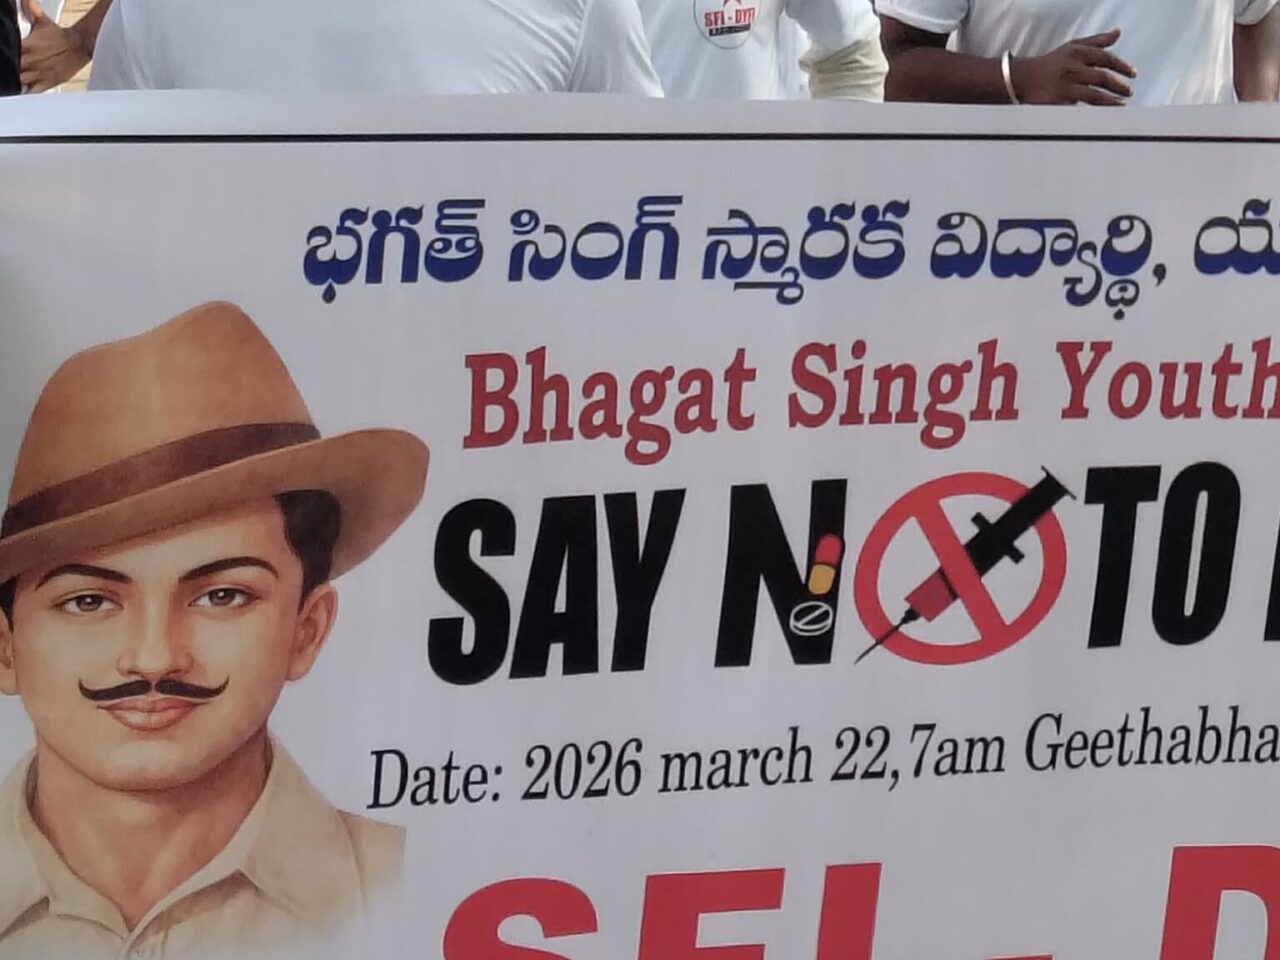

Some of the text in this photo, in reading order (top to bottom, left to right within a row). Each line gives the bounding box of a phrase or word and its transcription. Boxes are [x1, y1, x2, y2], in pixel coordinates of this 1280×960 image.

[704, 10, 725, 27] SFI
[303, 198, 486, 304] భగత్
[507, 194, 684, 282] సింగ్
[701, 200, 910, 306] స్మారక
[929, 211, 1168, 321] విద్యార్థి,
[463, 347, 757, 465] Bhagat
[788, 339, 1018, 449] Singh
[427, 488, 687, 686] SAY
[1084, 461, 1242, 649] TO
[366, 748, 503, 810] Date:
[521, 737, 643, 800] 2026
[657, 725, 814, 794] march
